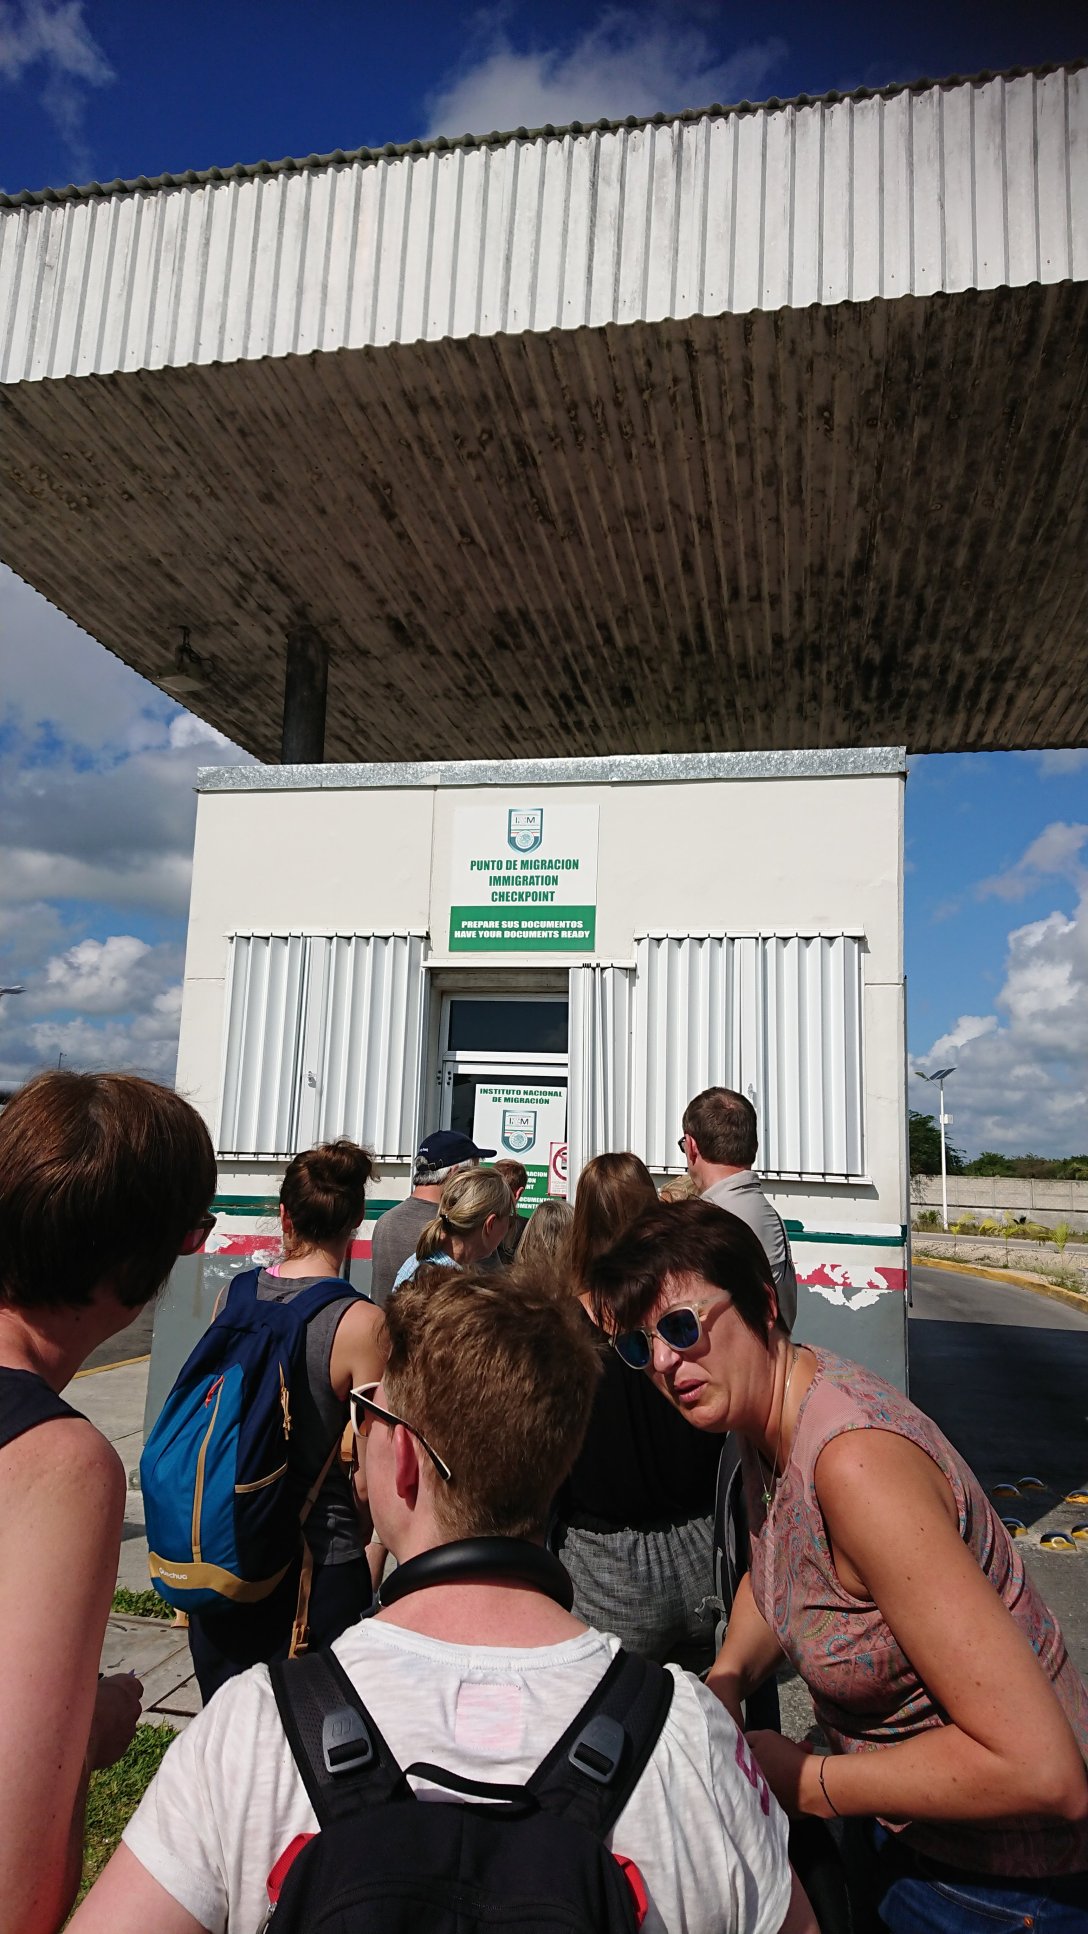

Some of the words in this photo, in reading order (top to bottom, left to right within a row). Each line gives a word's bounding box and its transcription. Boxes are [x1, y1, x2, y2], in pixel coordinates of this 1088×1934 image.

[470, 860, 503, 871] PUNTO
[505, 859, 518, 871] DE
[520, 858, 579, 870] MIGRACION
[488, 875, 559, 886] IMMIGRATION
[491, 890, 556, 902] CHECKPOINT
[461, 920, 500, 929] PREPARE
[501, 920, 520, 928] SUS
[521, 920, 583, 929] DOCUMENTOS
[454, 930, 477, 939] HAVE
[478, 930, 502, 938] YOUR
[503, 930, 560, 938] DOCUMENTS
[560, 930, 591, 938] READY
[480, 1088, 522, 1096] INSTITUTO
[523, 1089, 563, 1098] NACIONAL
[503, 1096, 550, 1105] MIGRACIÓN
